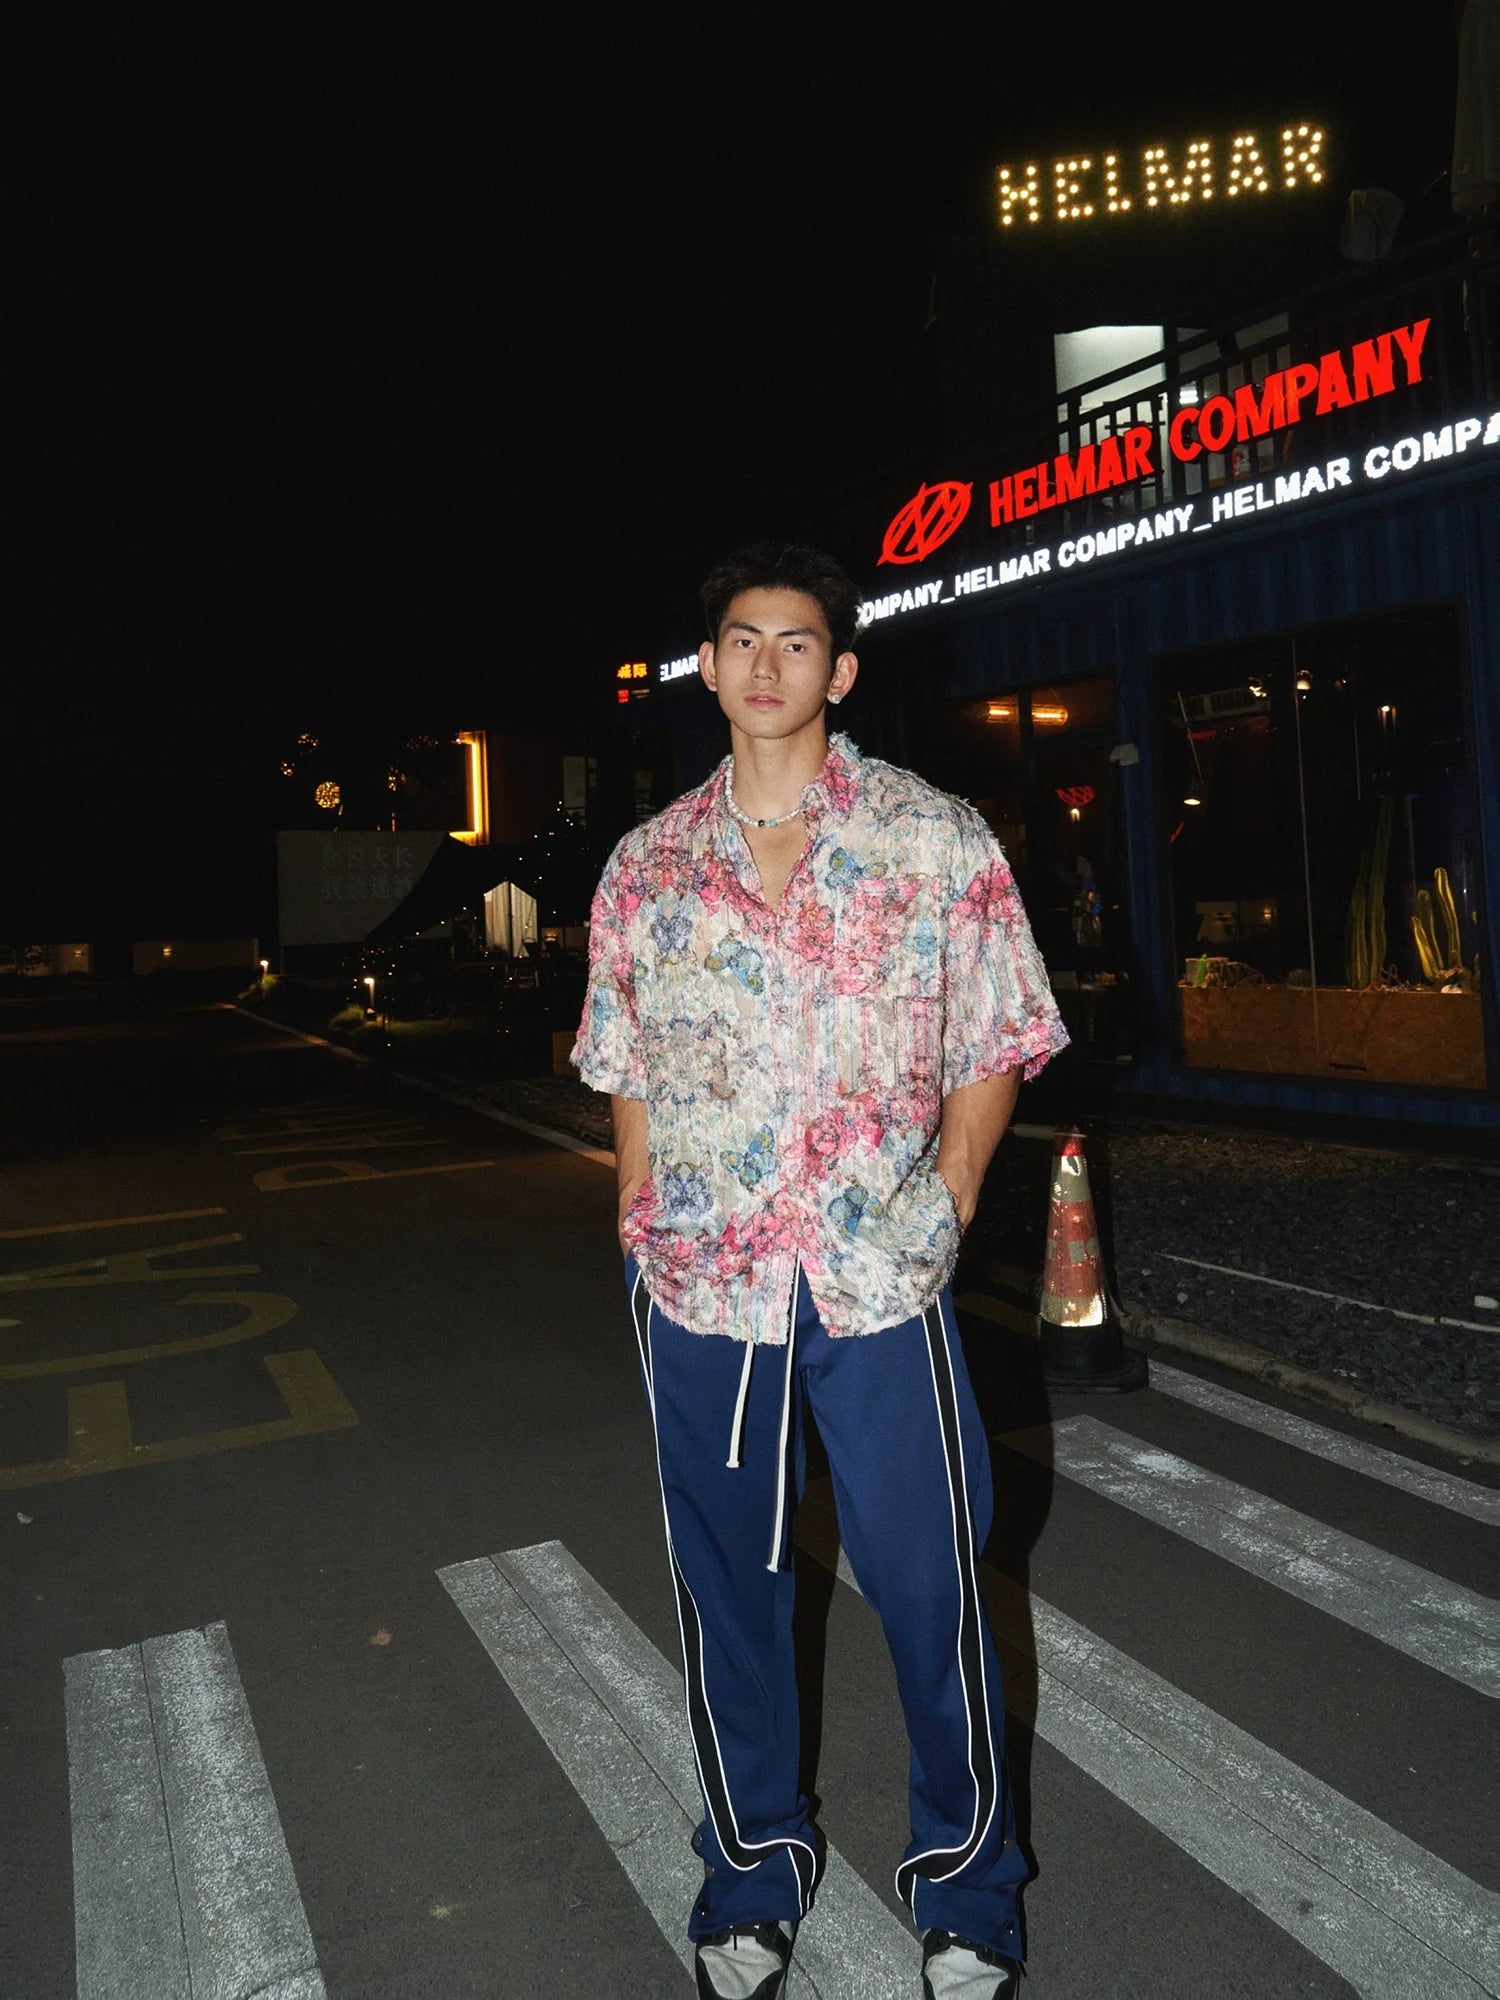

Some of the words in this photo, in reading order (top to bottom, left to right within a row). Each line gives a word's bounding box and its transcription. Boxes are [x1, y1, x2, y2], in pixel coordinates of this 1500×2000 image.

[998, 122, 1325, 227] HELMAR
[989, 426, 1154, 527] HELMAR
[1169, 318, 1431, 463] COMPANY
[857, 548, 1052, 626] OMPANY_HELMAR
